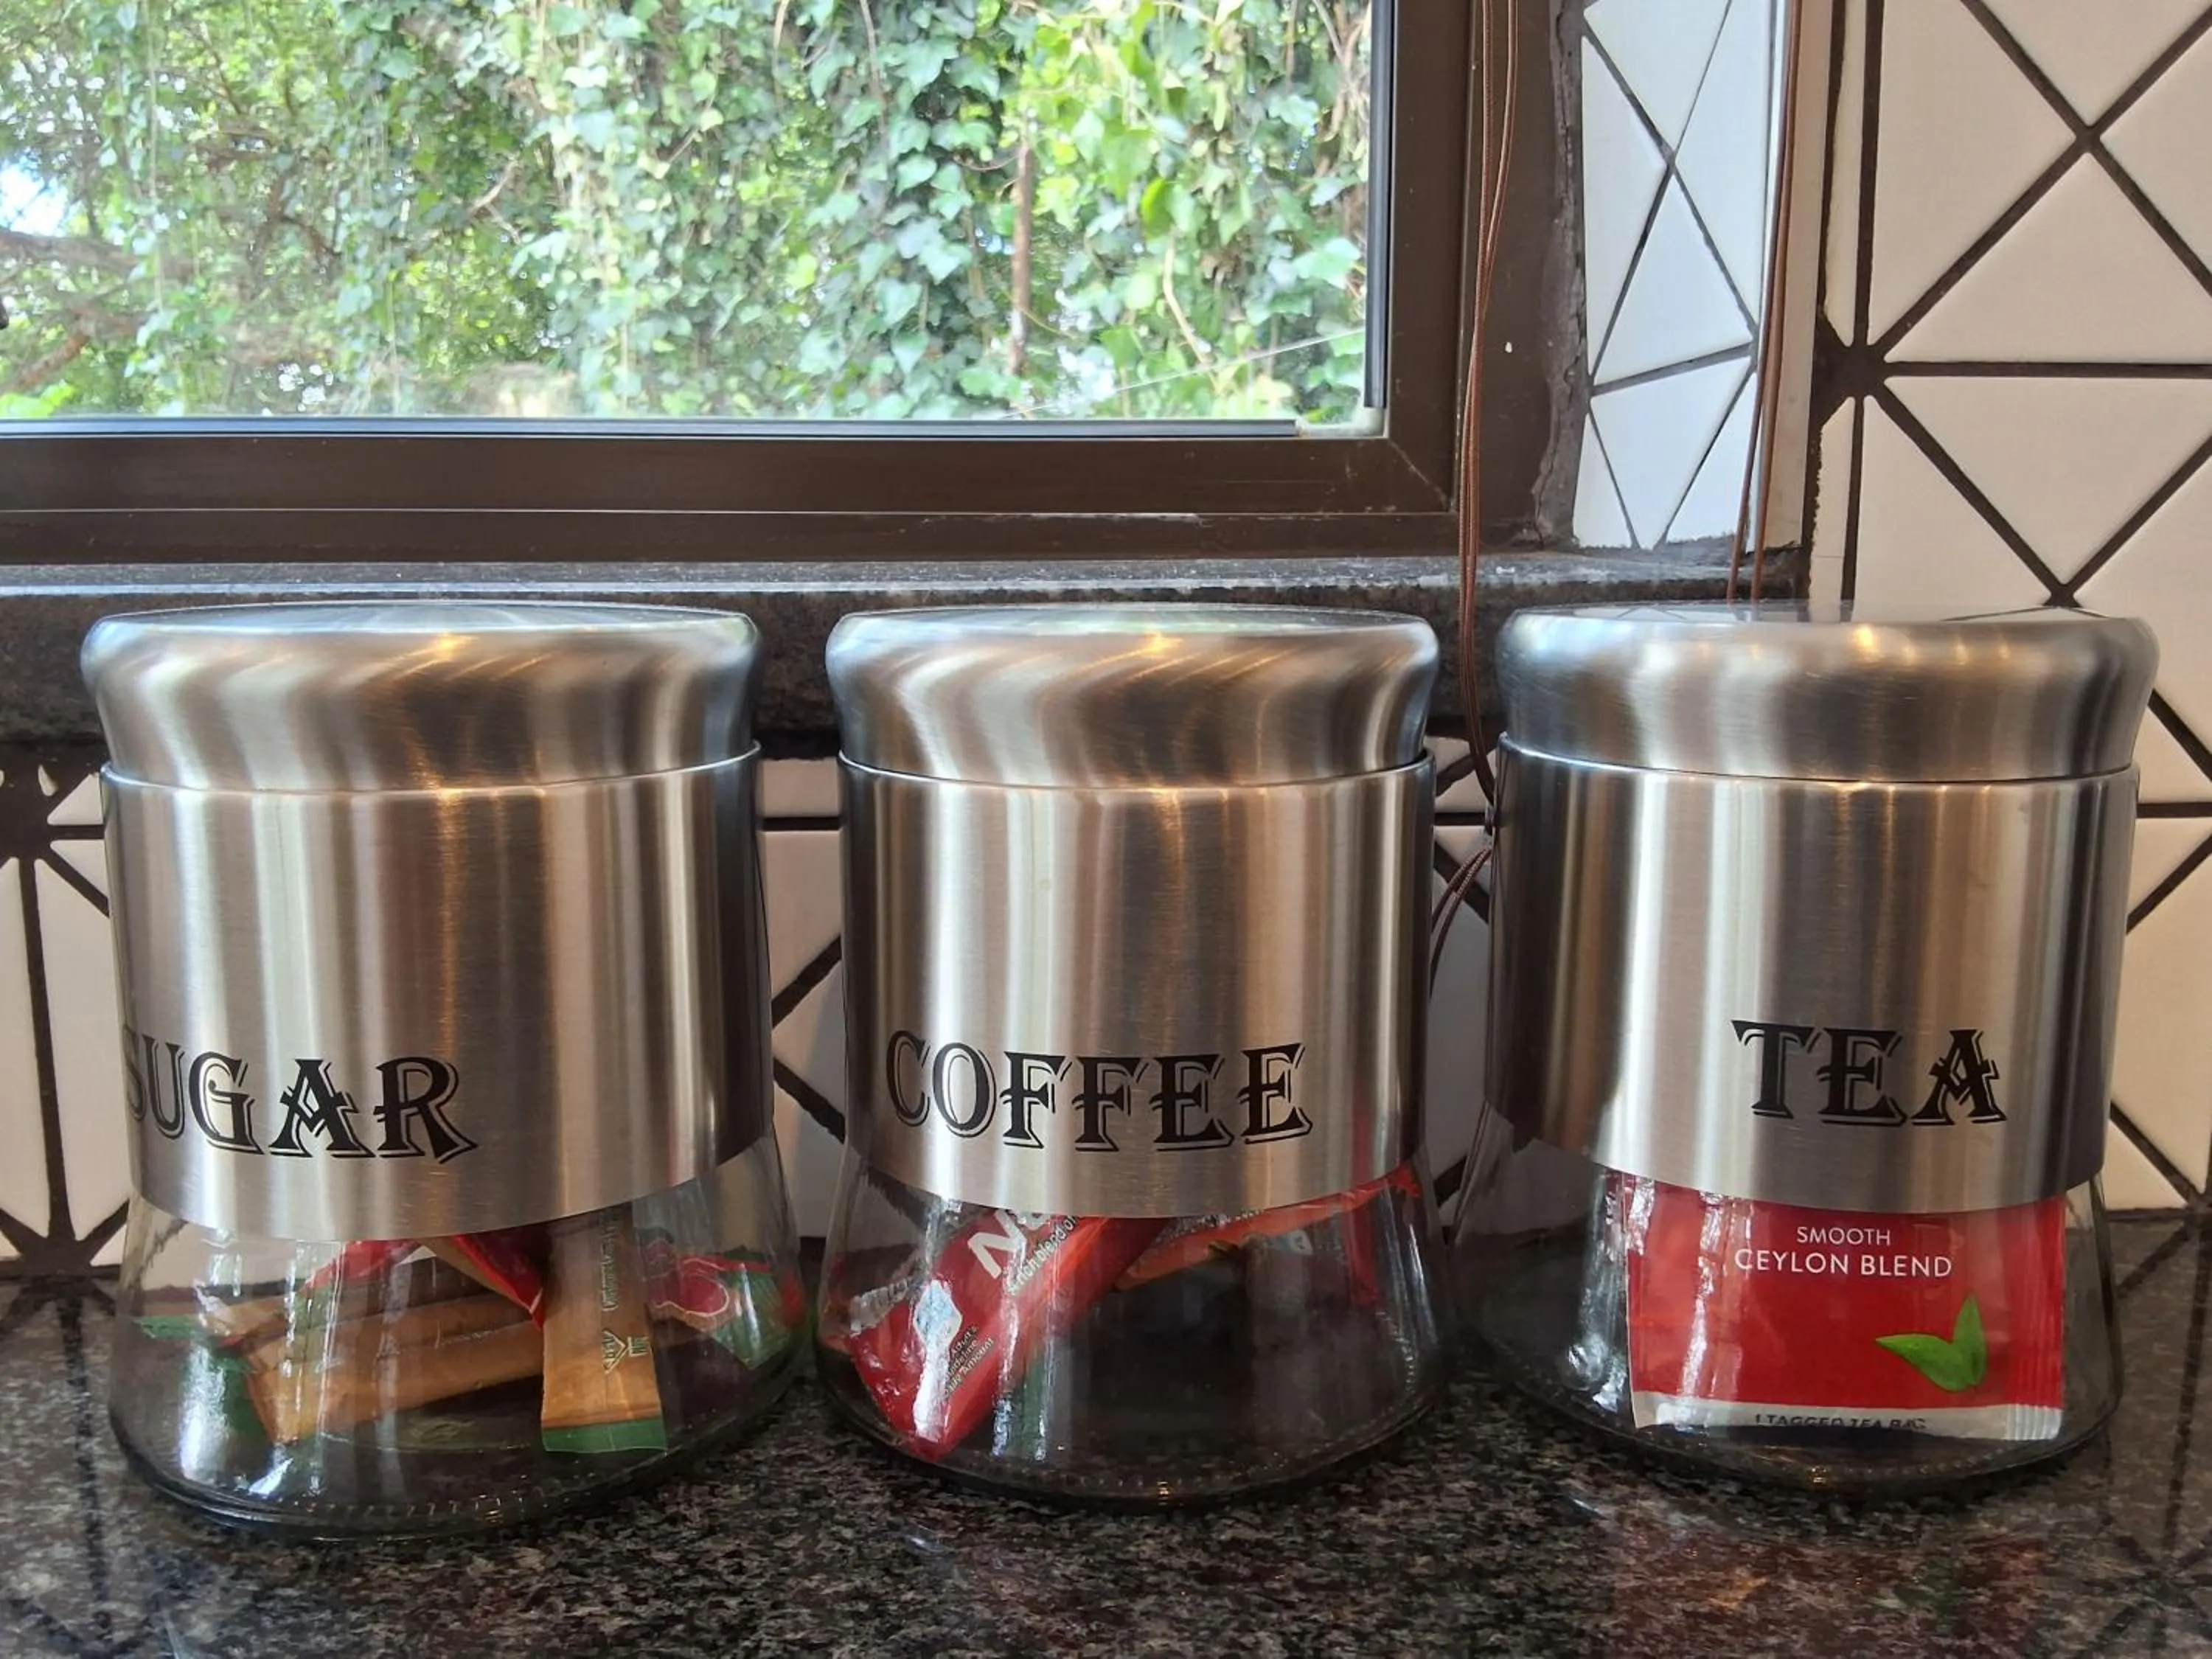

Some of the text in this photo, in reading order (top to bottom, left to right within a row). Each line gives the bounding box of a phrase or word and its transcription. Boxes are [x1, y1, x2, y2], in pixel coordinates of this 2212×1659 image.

[886, 1030, 1313, 1152] COFFEE
[1731, 1020, 2007, 1127] TEA
[1036, 1222, 1068, 1263] blend
[1796, 1226, 1891, 1245] SMOOTH
[1734, 1248, 1952, 1277] CEYLON BLEND
[1849, 1417, 1880, 1428] TEA
